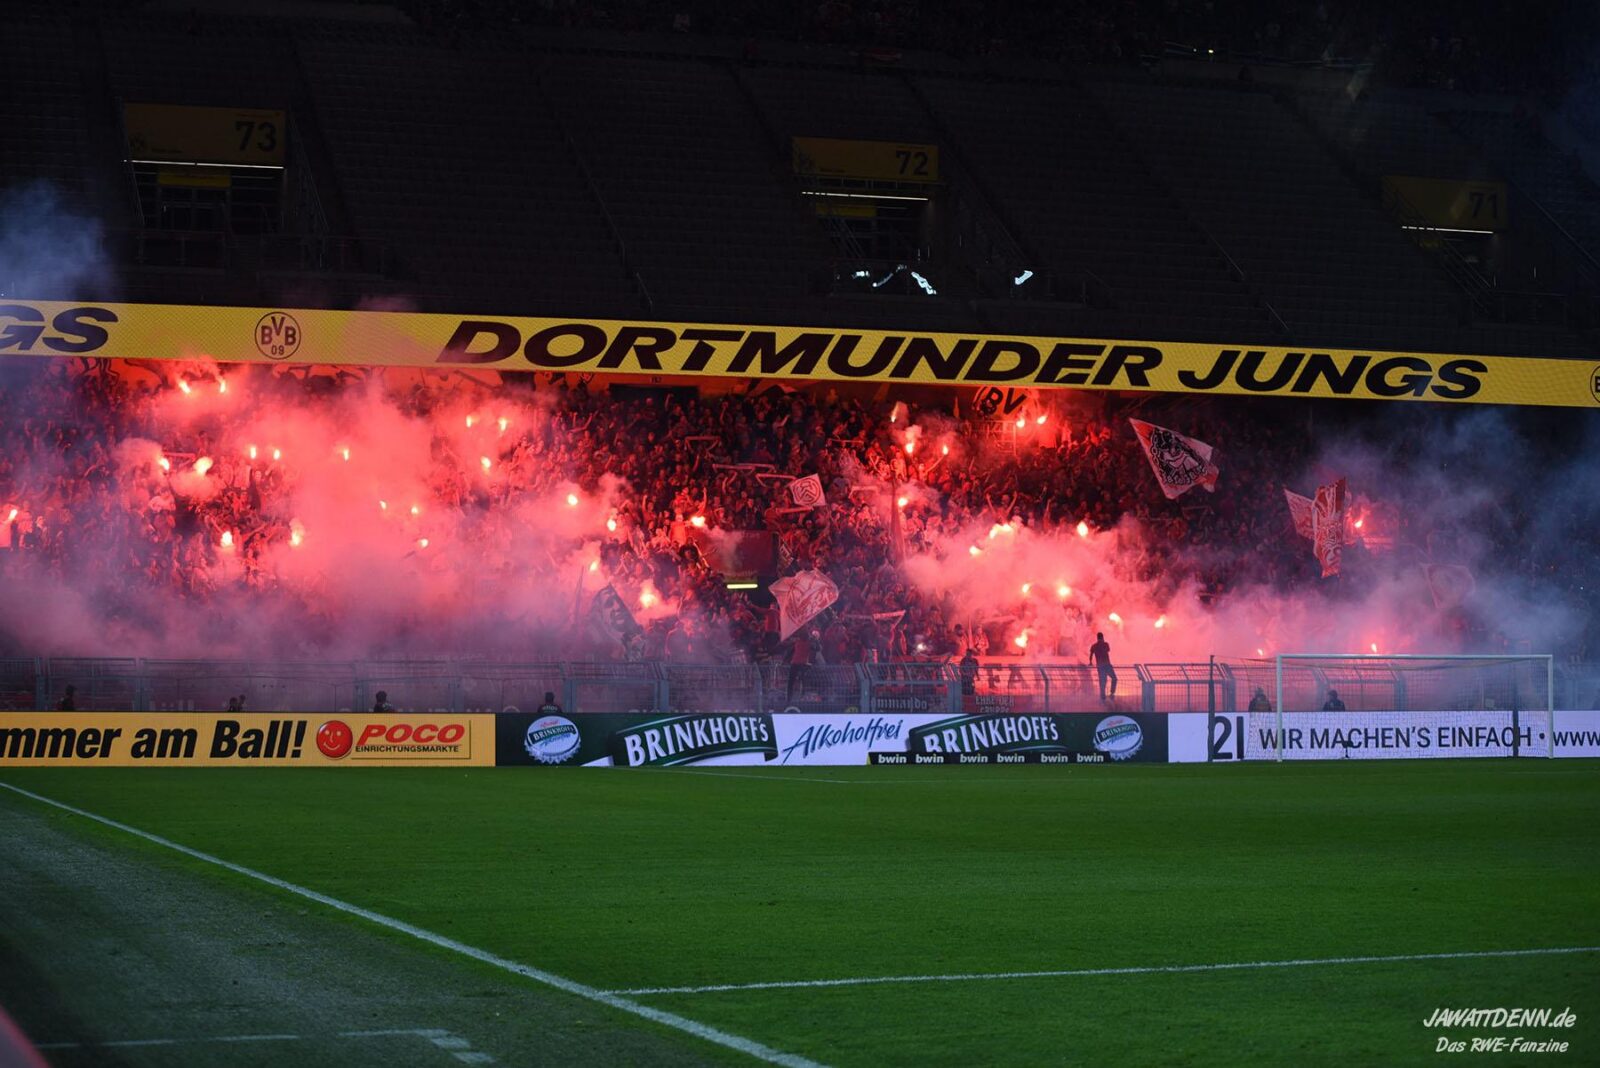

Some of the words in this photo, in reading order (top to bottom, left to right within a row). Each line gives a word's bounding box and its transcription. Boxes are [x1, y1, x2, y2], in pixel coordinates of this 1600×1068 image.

[235, 121, 276, 153] 73
[896, 150, 928, 176] 72
[1471, 193, 1497, 219] 71
[261, 316, 296, 345] BVB
[271, 345, 284, 355] 09
[435, 320, 1163, 387] DORTMUNDER
[1178, 350, 1488, 399] JUNGS
[131, 727, 197, 758] am
[210, 720, 307, 758] Ball!
[357, 724, 465, 746] POCO
[624, 716, 768, 766] BRINKHOFF's
[782, 718, 903, 764] Alkoholfrei
[1259, 728, 1304, 749] WIR
[1310, 727, 1431, 750] MACHEN'S
[878, 753, 907, 763] bwin
[915, 753, 944, 763] bwin
[960, 753, 988, 763] bwin
[997, 753, 1025, 763] bwin
[1040, 753, 1068, 763] bwin
[1077, 753, 1104, 763] bwin
